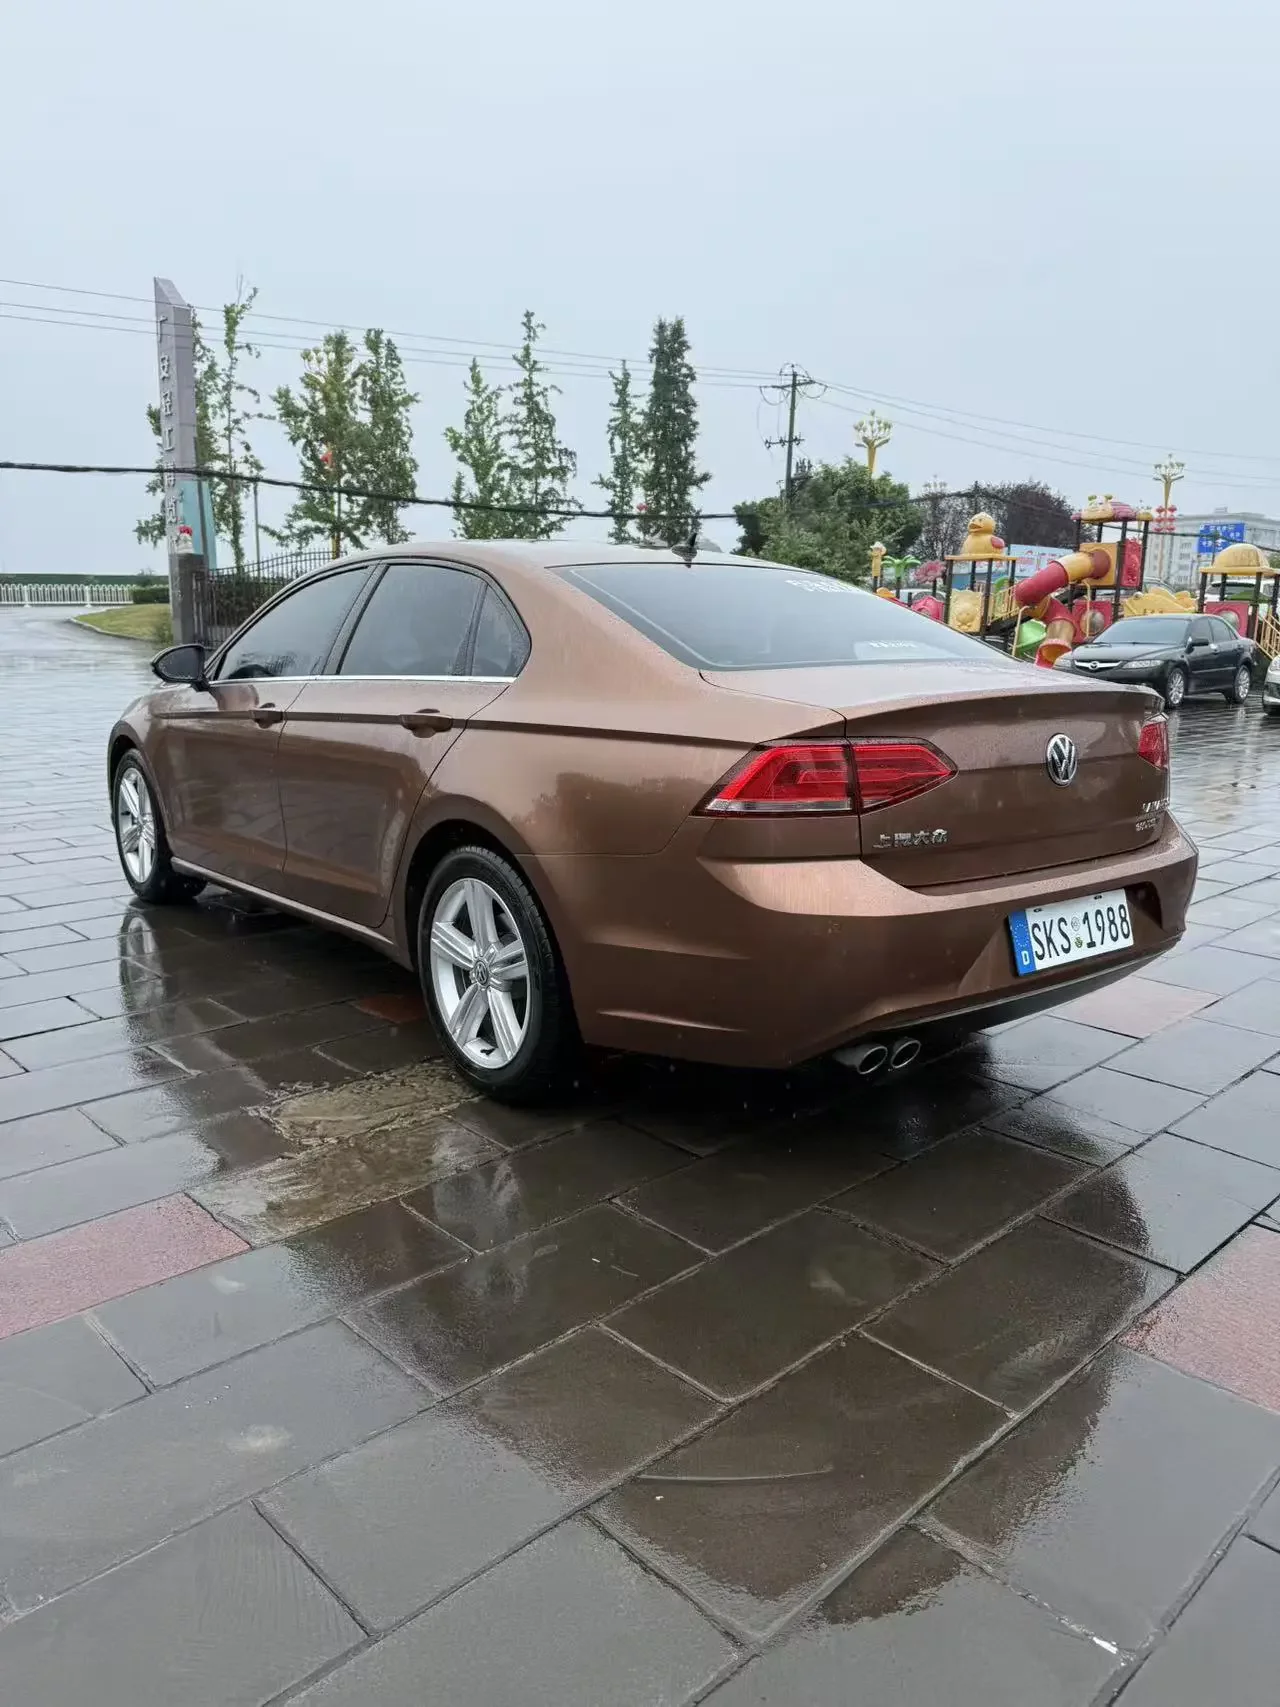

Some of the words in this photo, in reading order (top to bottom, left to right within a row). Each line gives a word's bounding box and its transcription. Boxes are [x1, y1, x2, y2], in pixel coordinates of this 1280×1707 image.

[1031, 917, 1072, 961] SKS
[1082, 903, 1131, 949] 1988
[1021, 950, 1030, 965] D
